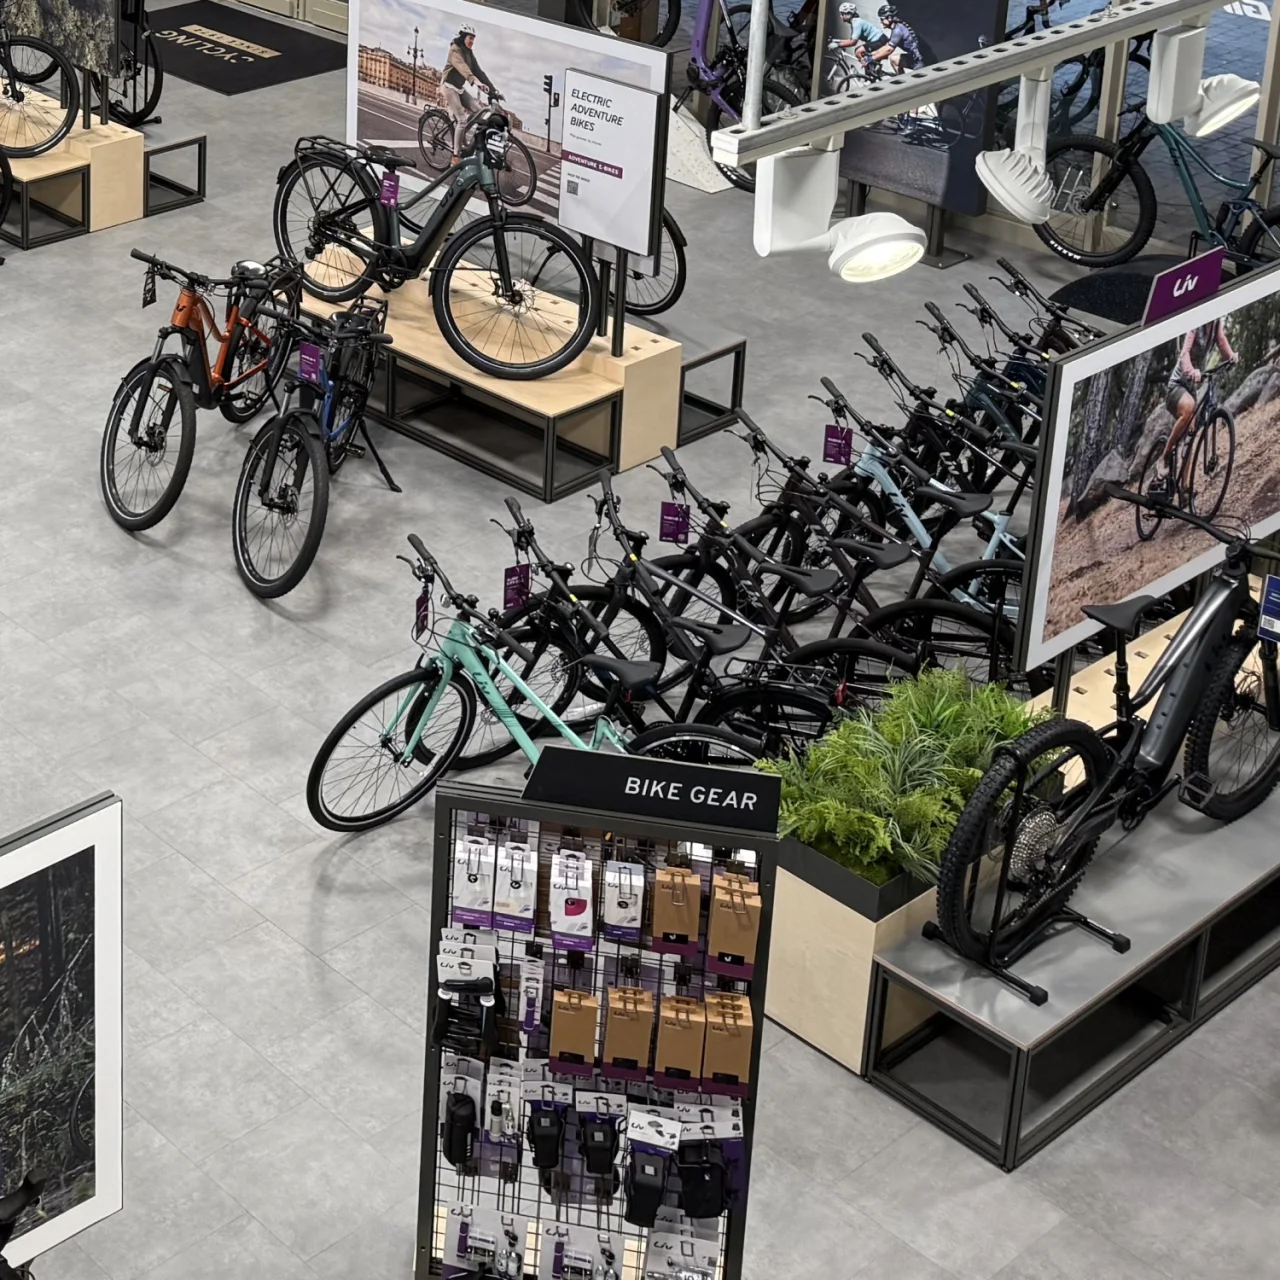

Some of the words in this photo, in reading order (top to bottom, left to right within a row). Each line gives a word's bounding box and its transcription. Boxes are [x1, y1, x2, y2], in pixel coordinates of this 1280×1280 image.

[571, 88, 612, 108] ELECTRIC
[570, 103, 624, 126] ADVENTURE
[570, 116, 595, 132] BIKES
[568, 154, 597, 169] ADVENTURE
[1173, 274, 1198, 297] Liv
[624, 776, 683, 801] BIKE
[690, 786, 757, 811] GEAR
